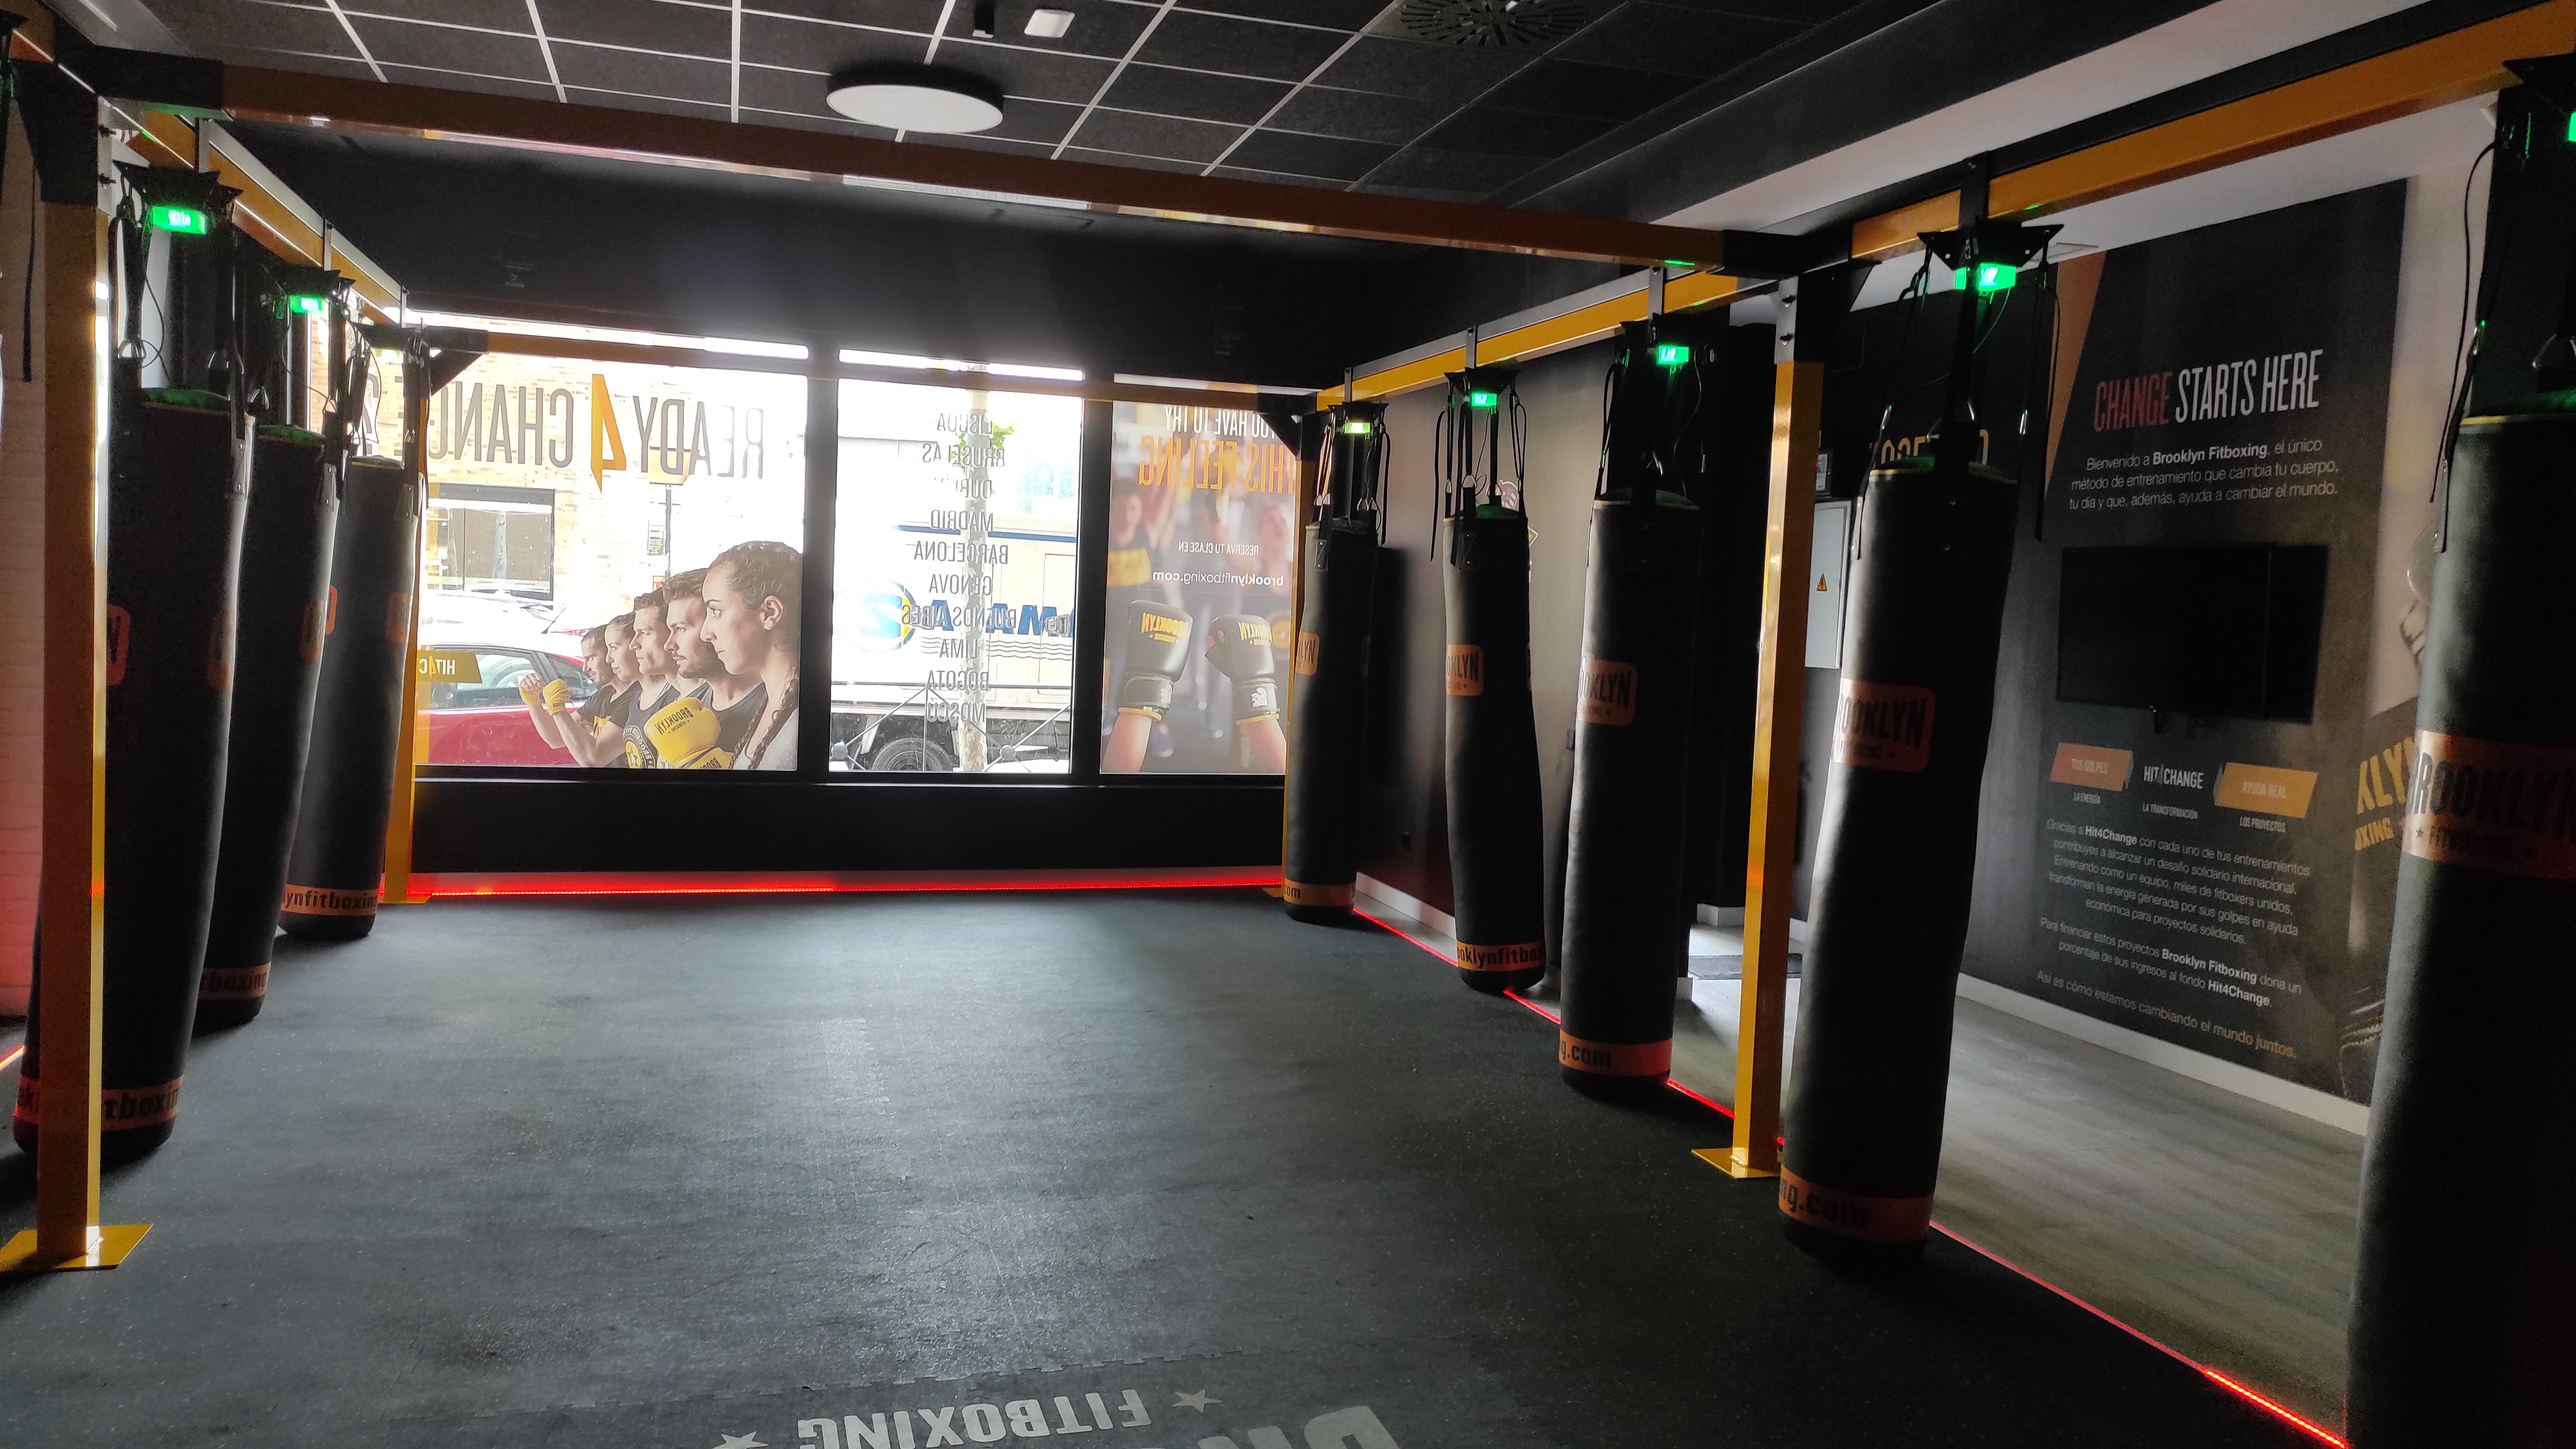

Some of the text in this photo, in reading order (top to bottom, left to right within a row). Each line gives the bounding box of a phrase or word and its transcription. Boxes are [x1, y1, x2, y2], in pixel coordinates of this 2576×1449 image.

[2095, 349, 2323, 432] CHANGE STARTS HERE
[2071, 461, 2339, 490] método de entrenamiento que cambia tu cuerpo,
[2086, 454, 2140, 471] Bienvenido
[2143, 455, 2150, 466] a
[2152, 449, 2205, 465] Brooklyn
[2275, 440, 2285, 455] el
[2288, 438, 2322, 453] único
[2069, 497, 2079, 510] tu
[2081, 496, 2096, 509] día
[2098, 499, 2104, 511] y
[2178, 489, 2212, 506] ayuda
[2216, 490, 2222, 501] a
[2226, 485, 2273, 501] cambiar
[2276, 482, 2287, 497] el
[2290, 480, 2338, 496] mundo.
[2142, 803, 2149, 812] LA
[2239, 816, 2286, 833] LOS PROYECTOS
[2047, 818, 2076, 833] Gracias
[2085, 825, 2137, 846] Hit4Change
[2140, 837, 2156, 848] con
[2158, 841, 2180, 853] cada
[2182, 846, 2200, 856] uno
[2202, 847, 2214, 859] de
[2217, 850, 2231, 862] tus
[2234, 854, 2310, 877] entrenamientos
[2054, 839, 2099, 856] contribuyes
[2100, 847, 2106, 857] a
[2108, 849, 2142, 864] alcanzar
[2144, 857, 2156, 867] un
[2191, 866, 2230, 882] solidario
[2232, 872, 2297, 895] internacional.
[2055, 855, 2099, 874] Entrenando
[2101, 866, 2125, 879] como
[2126, 872, 2137, 881] un
[2174, 881, 2197, 894] miles
[2200, 886, 2212, 897] de
[2214, 887, 2255, 907] fitboxers
[2257, 899, 2293, 916] unidos,
[2097, 882, 2104, 892] la
[2138, 892, 2179, 909] generada
[2181, 902, 2197, 913] por
[2199, 906, 2215, 918] sus
[2218, 910, 2250, 925] golpes
[2252, 918, 2265, 929] en
[2267, 920, 2299, 937] ayuda
[2085, 898, 2130, 917] económica
[2132, 910, 2151, 922] para
[2154, 915, 2198, 933] proyectos
[2040, 917, 2059, 932] Para
[2094, 933, 2116, 946] estos
[2117, 939, 2160, 958] proyectos
[2162, 948, 2206, 970] Brooklyn
[2208, 959, 2257, 985] Fitboxing
[2260, 974, 2286, 990] dona
[2288, 983, 2302, 994] un
[2059, 941, 2100, 961] porcentaje
[2101, 953, 2113, 963] de
[2114, 957, 2129, 968] sus
[2130, 958, 2167, 978] ingresos
[2169, 970, 2177, 981] al
[2179, 972, 2205, 989] fondo
[2053, 978, 2064, 989] es
[2066, 980, 2092, 997] cómo
[2094, 989, 2137, 1010] estamos
[2139, 1003, 2198, 1028] cambiando
[2201, 1020, 2211, 1032] el
[2213, 1024, 2253, 1045] mundo
[2255, 1034, 2297, 1058] juntos.
[798, 1390, 1152, 1449] FITBOXING
